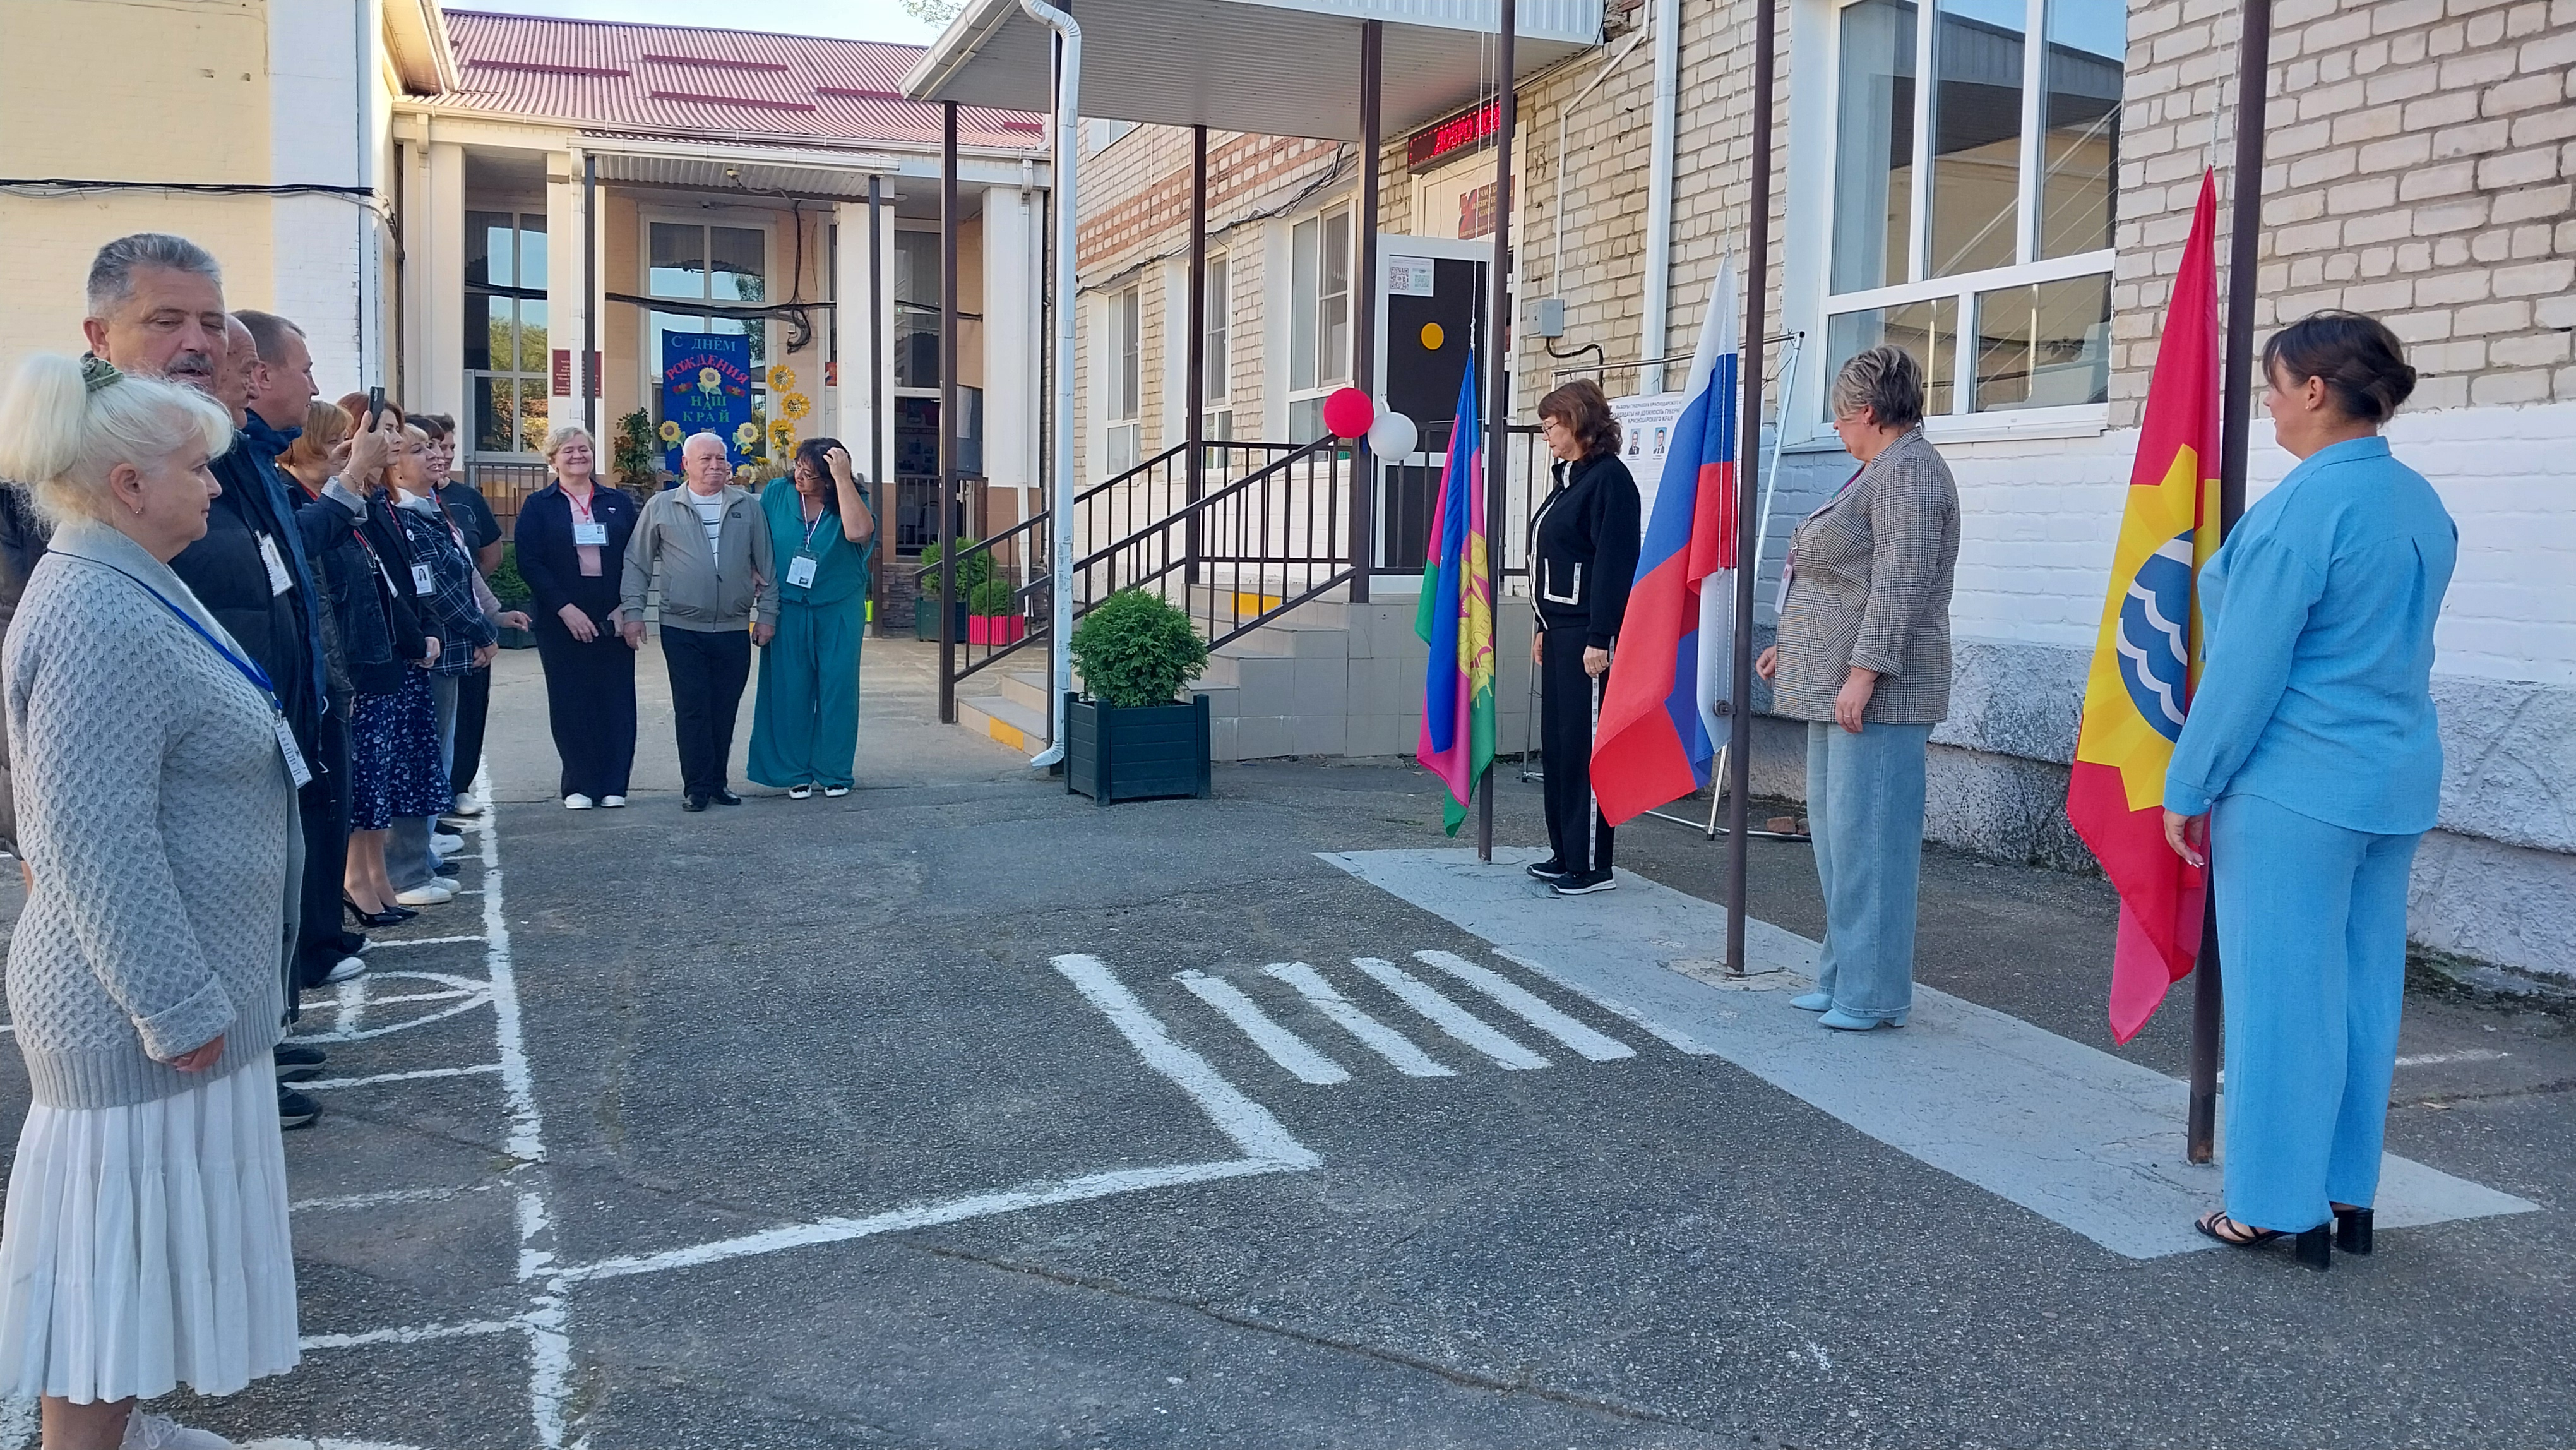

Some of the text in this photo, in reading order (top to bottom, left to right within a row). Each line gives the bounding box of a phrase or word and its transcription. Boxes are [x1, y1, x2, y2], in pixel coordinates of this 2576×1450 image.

[671, 335, 736, 352] С ДНЁМ
[665, 354, 749, 384] РОЖДЕНИЯ
[691, 395, 727, 410] НАШ
[683, 410, 729, 422] КРАЙ
